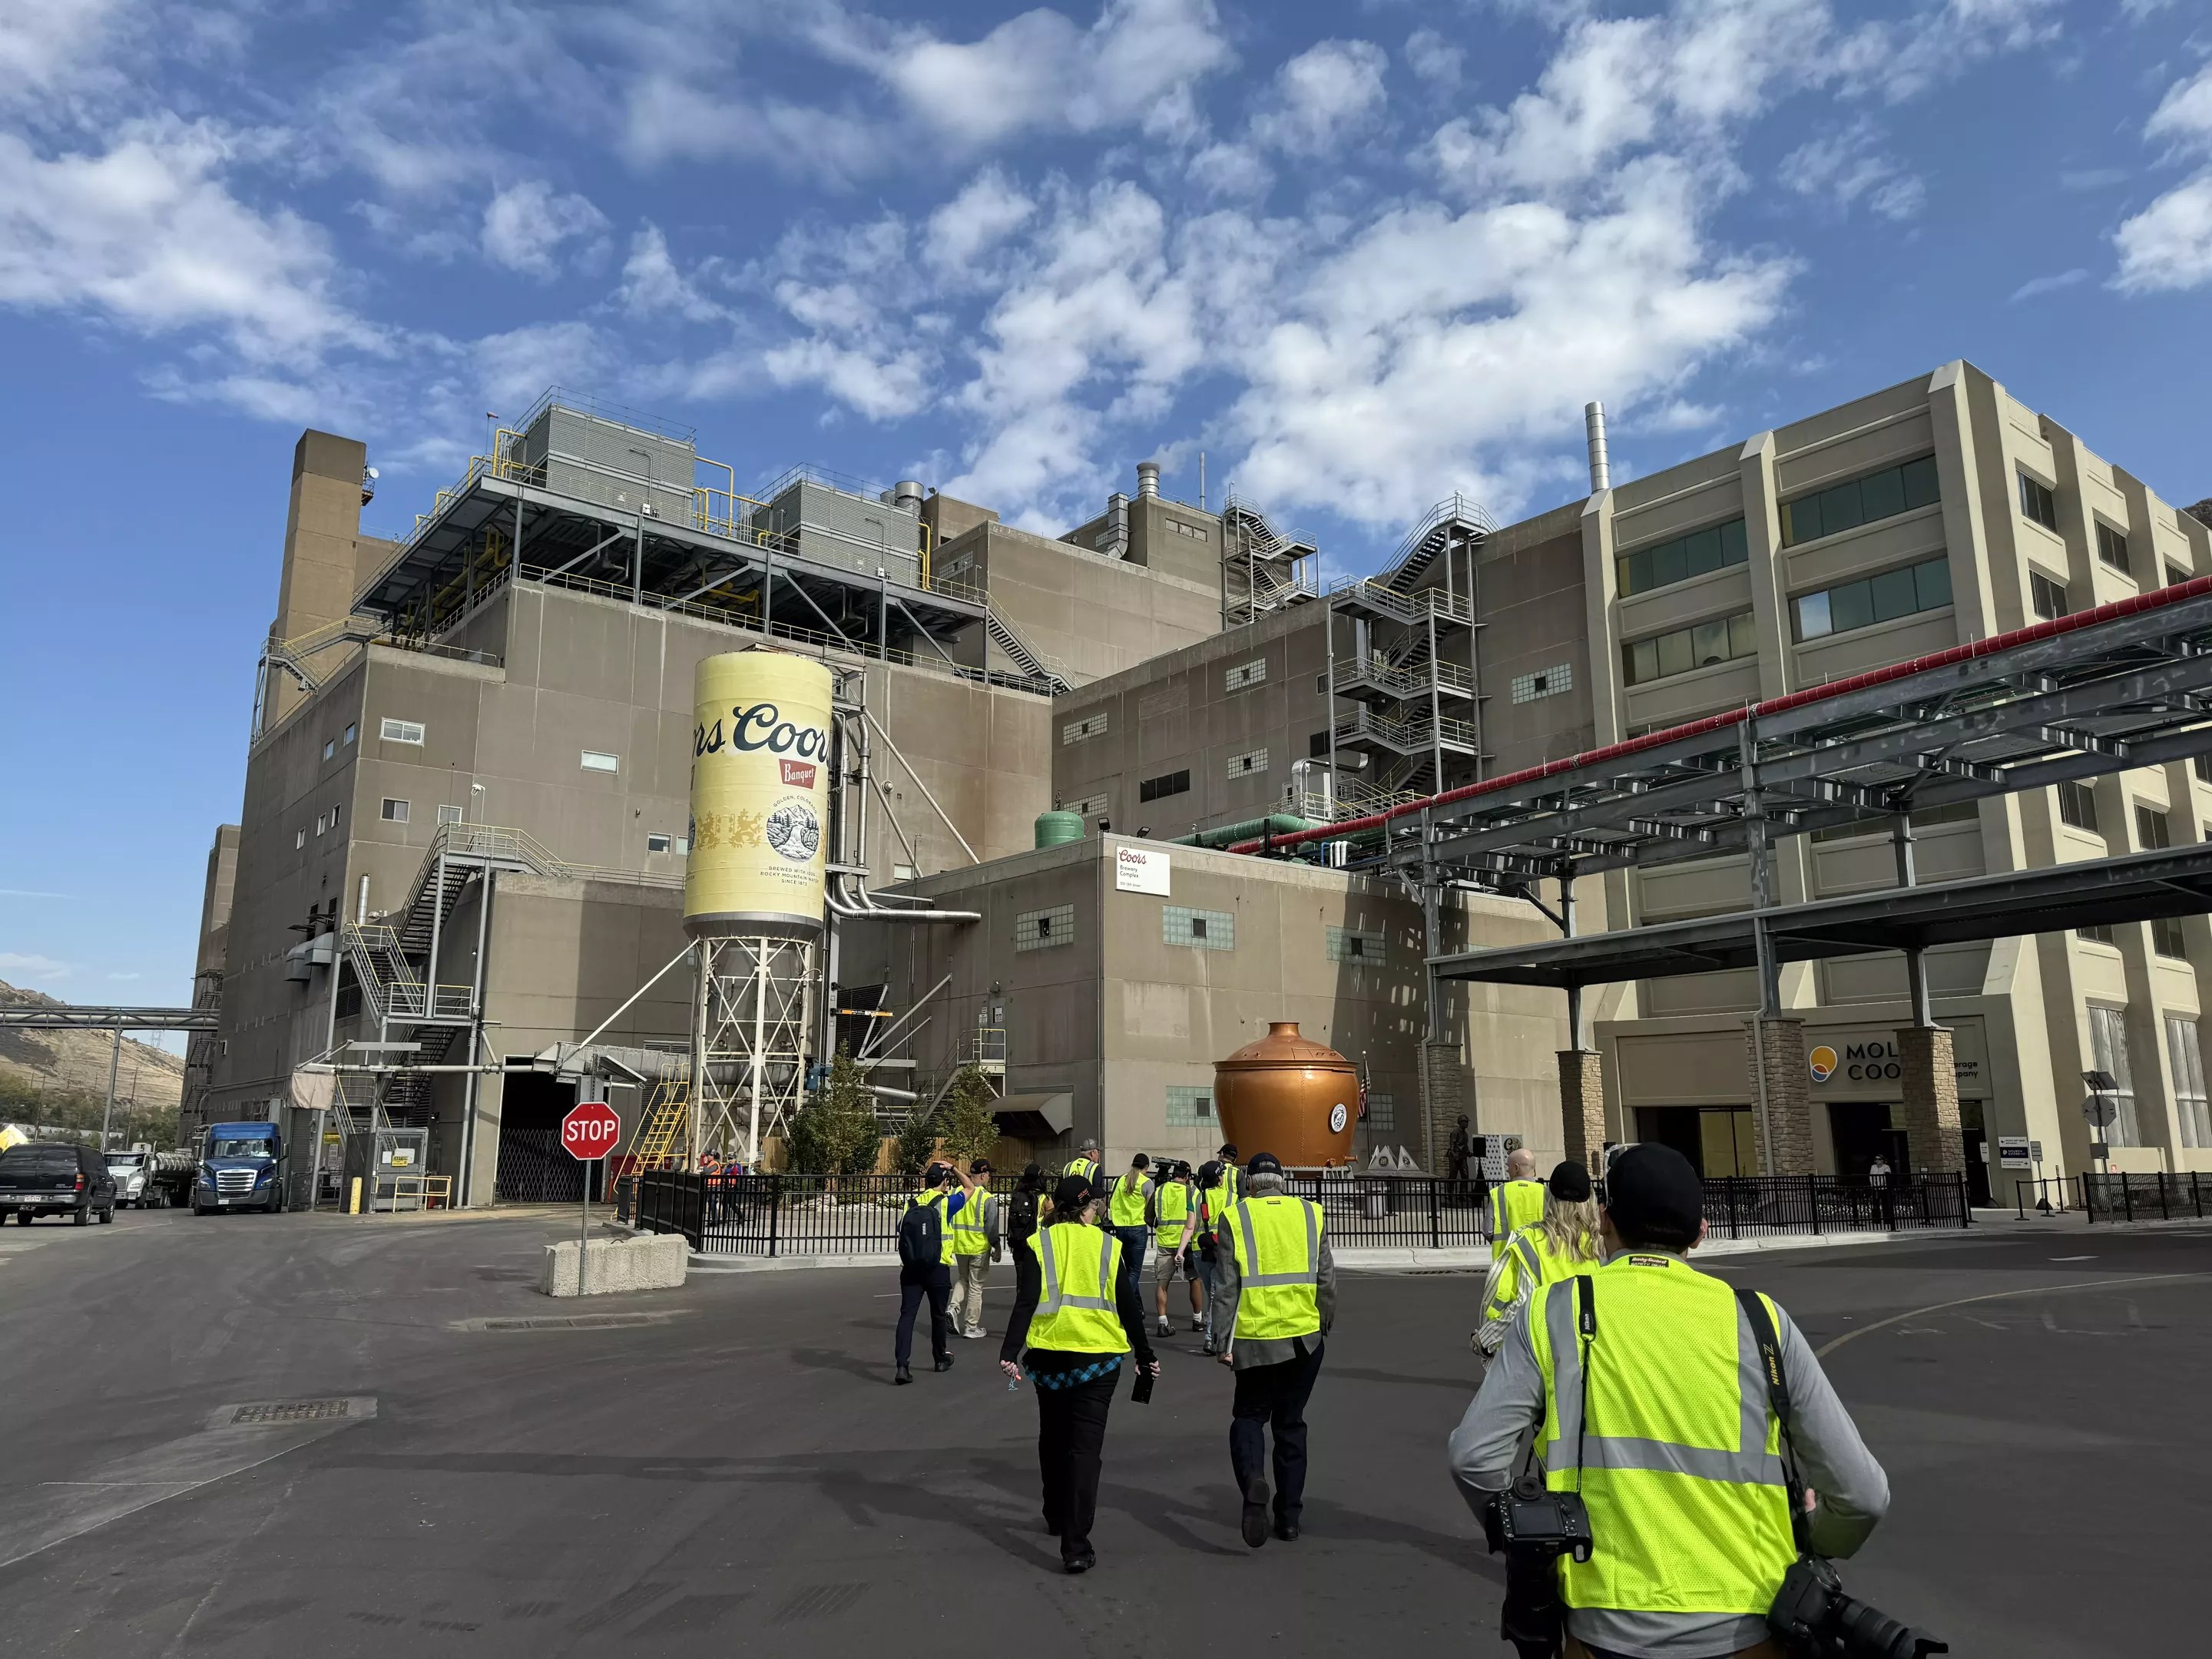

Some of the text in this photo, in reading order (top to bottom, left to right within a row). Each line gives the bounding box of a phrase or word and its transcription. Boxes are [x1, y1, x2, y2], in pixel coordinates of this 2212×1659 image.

[733, 703, 829, 764] Coor
[784, 763, 814, 783] Banquet
[773, 795, 817, 814] GOLDEN, COLORADO
[1118, 849, 1147, 865] Coors
[782, 873, 807, 881] MOUNTAIN
[1846, 1041, 1899, 1060] MOL
[1847, 1062, 1901, 1081] COO
[1955, 1071, 1979, 1079] pany
[566, 1119, 616, 1142] STOP
[1763, 1343, 1780, 1386] Nikon Z
